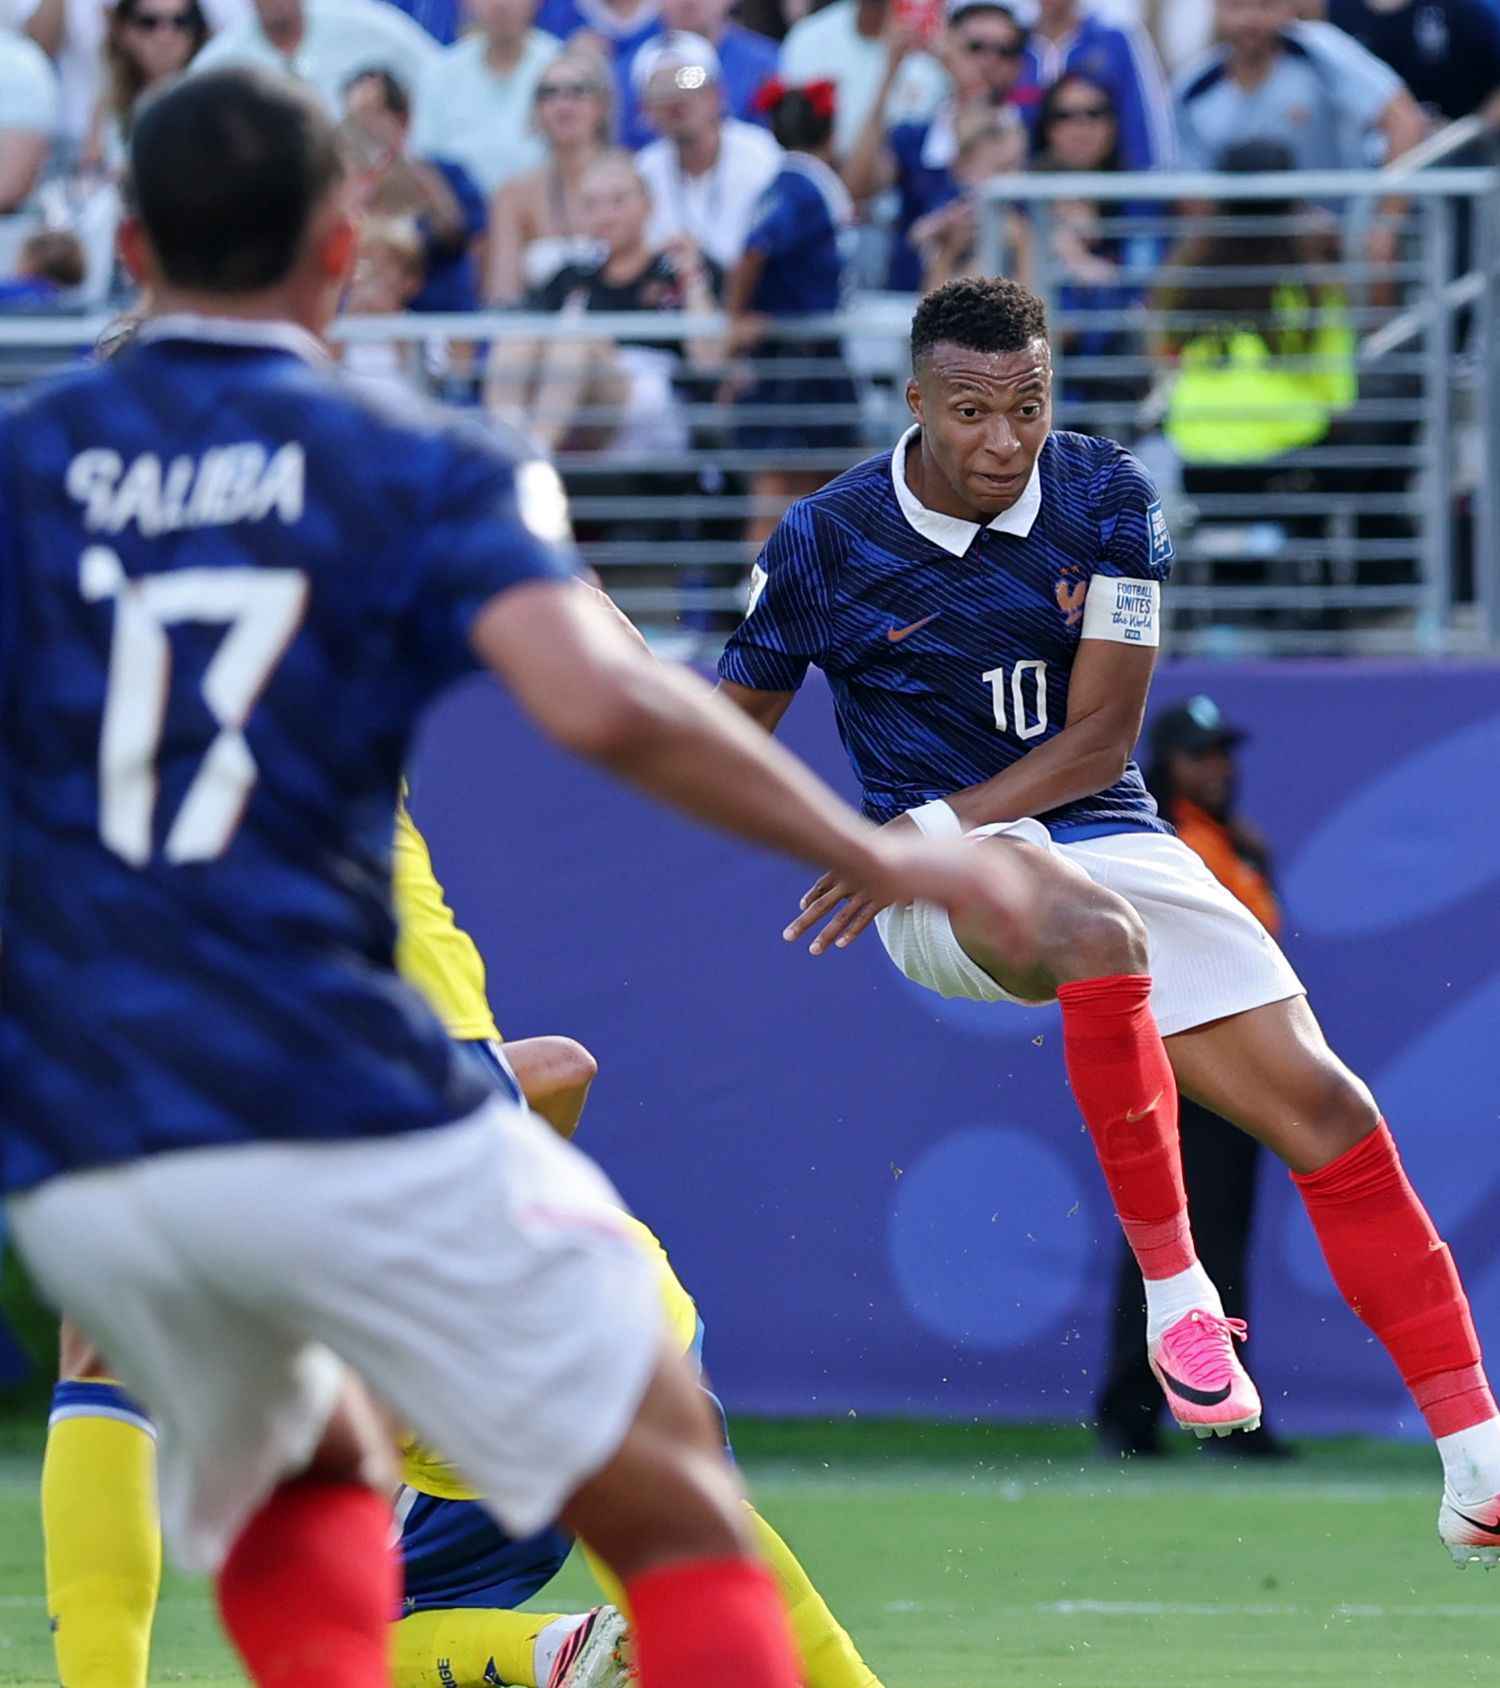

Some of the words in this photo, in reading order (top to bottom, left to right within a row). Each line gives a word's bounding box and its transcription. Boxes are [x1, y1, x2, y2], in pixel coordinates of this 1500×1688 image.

[66, 441, 306, 538] SALIBA
[1116, 594, 1152, 614] UNITES
[1117, 582, 1152, 598] FOOTBALL
[1111, 611, 1128, 625] the
[78, 545, 310, 869] 17
[982, 660, 1047, 740] 10
